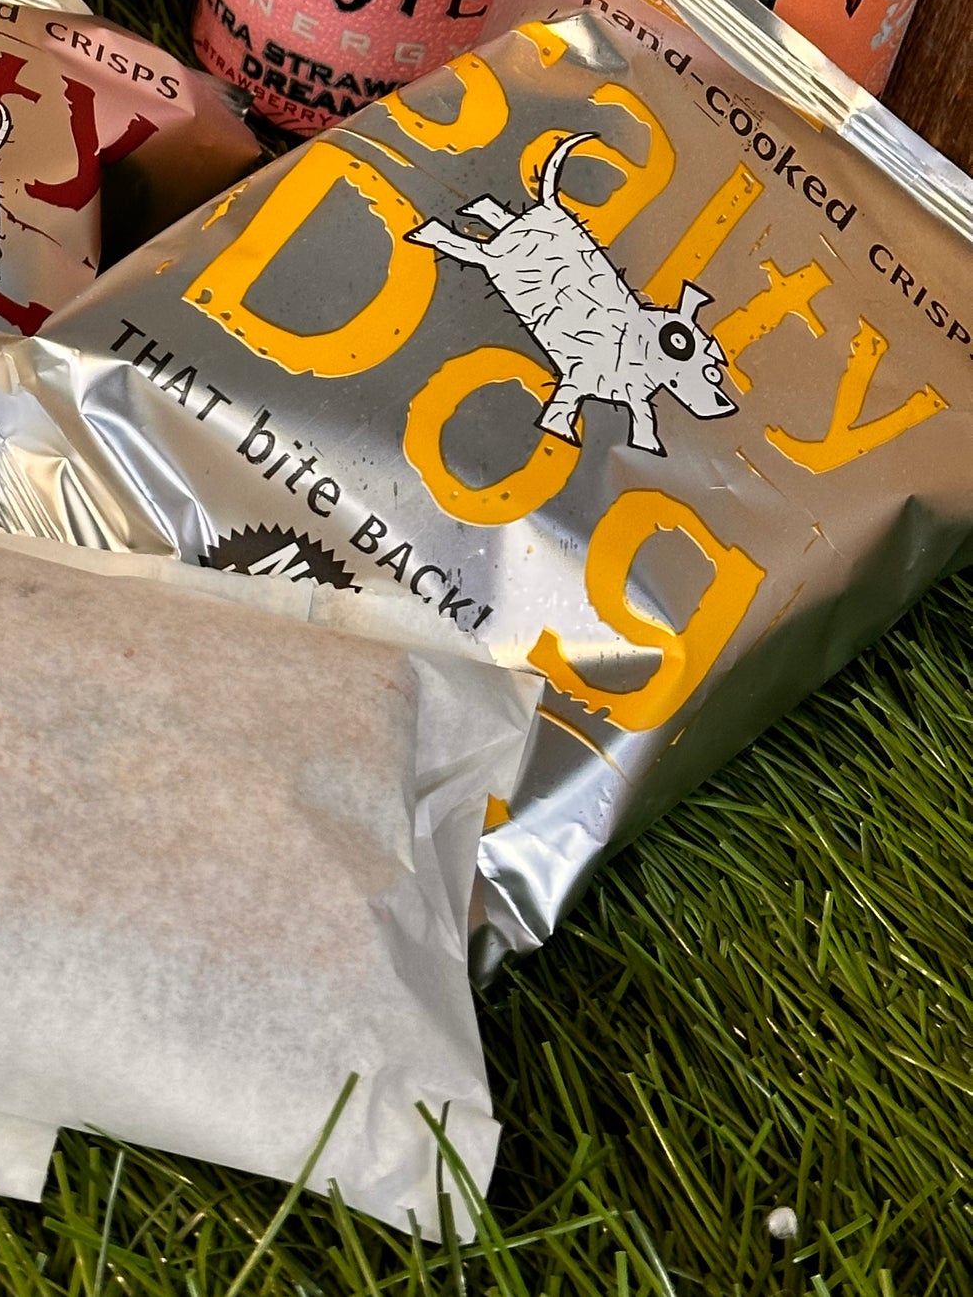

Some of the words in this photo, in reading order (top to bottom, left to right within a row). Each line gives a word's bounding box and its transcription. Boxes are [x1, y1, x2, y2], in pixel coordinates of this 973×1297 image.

[45, 20, 182, 102] CRISPS
[262, 38, 408, 99] STRAW
[867, 242, 973, 362] CRISP
[110, 318, 233, 422] THAT
[236, 403, 344, 519] bite
[181, 138, 769, 733] Dog
